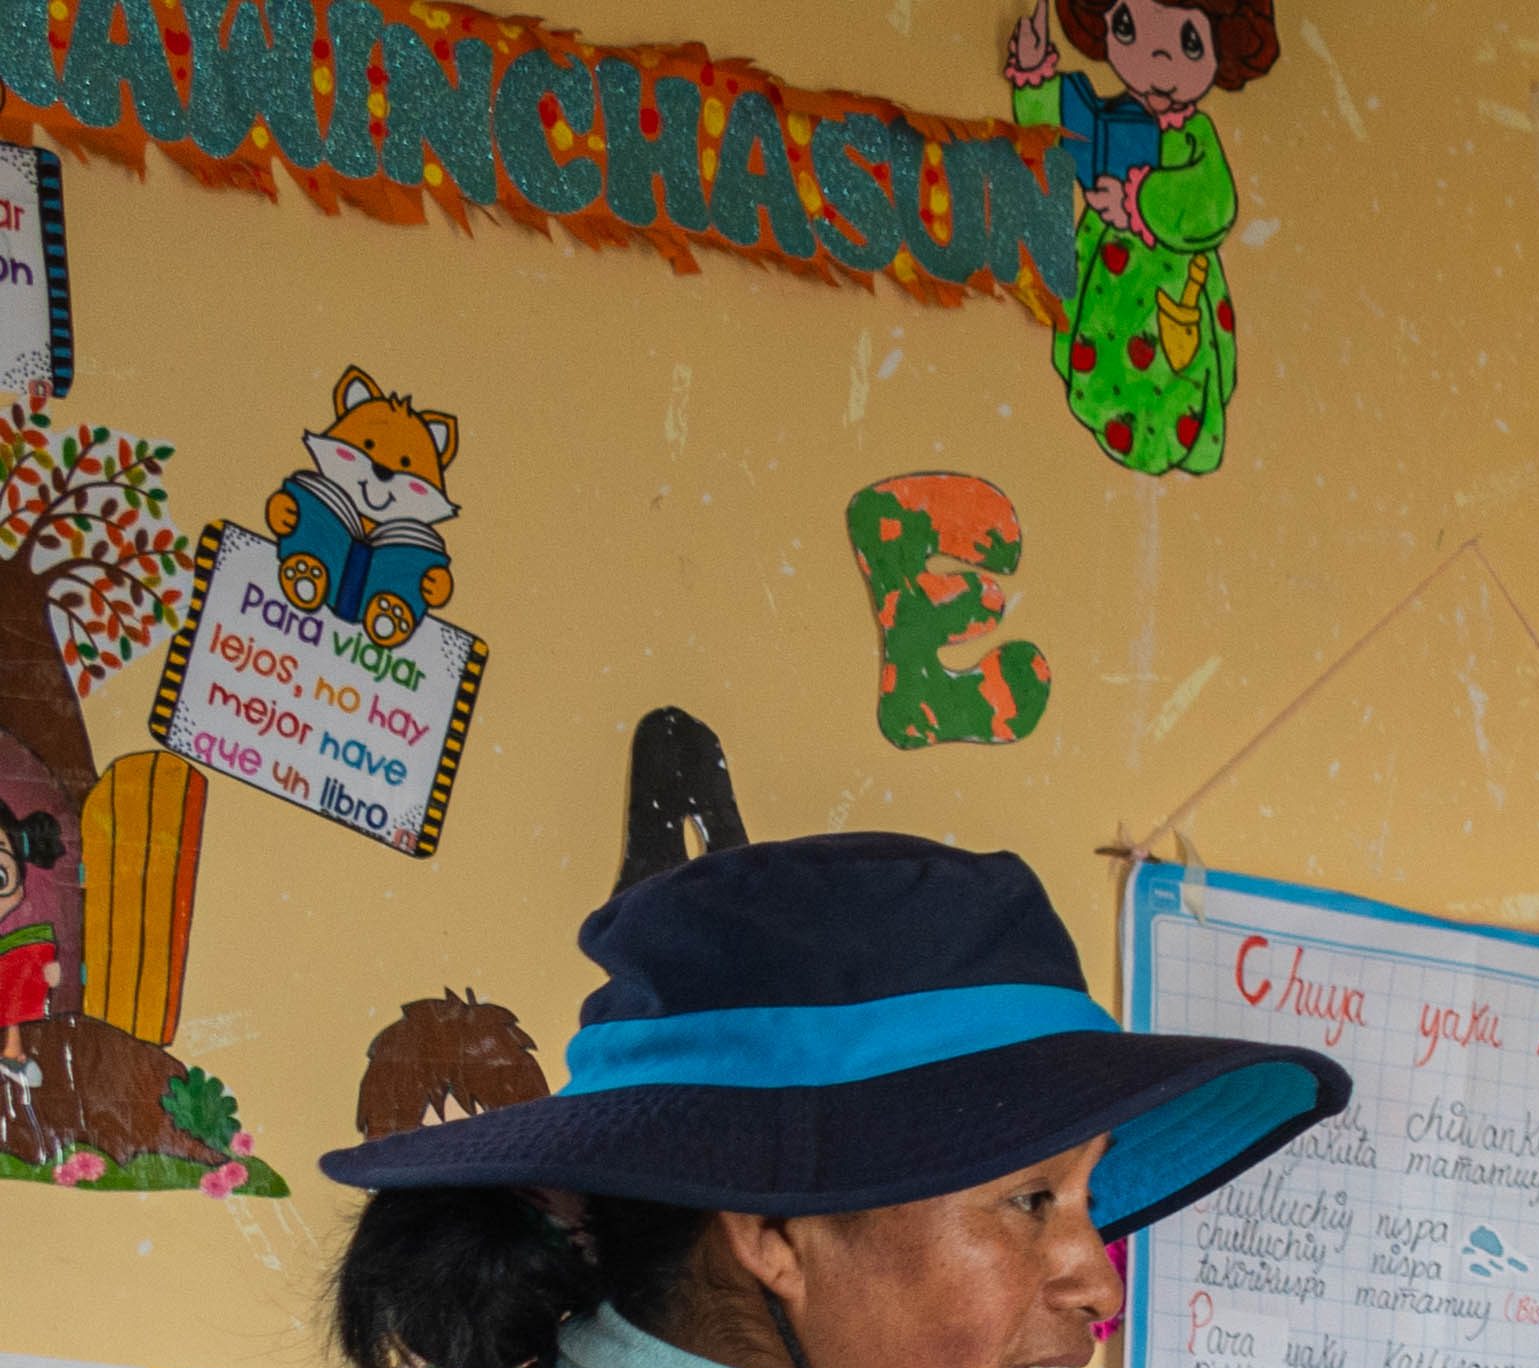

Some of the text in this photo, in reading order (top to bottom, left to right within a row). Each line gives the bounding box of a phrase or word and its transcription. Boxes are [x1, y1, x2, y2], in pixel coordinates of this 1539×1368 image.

[209, 624, 430, 747] lejos, no hay
[240, 581, 427, 692] Para viajar
[193, 731, 393, 836] que un libro.
[208, 682, 409, 787] mejor nave
[1236, 936, 1367, 1047] Chuya
[1187, 1290, 1256, 1359] Para
